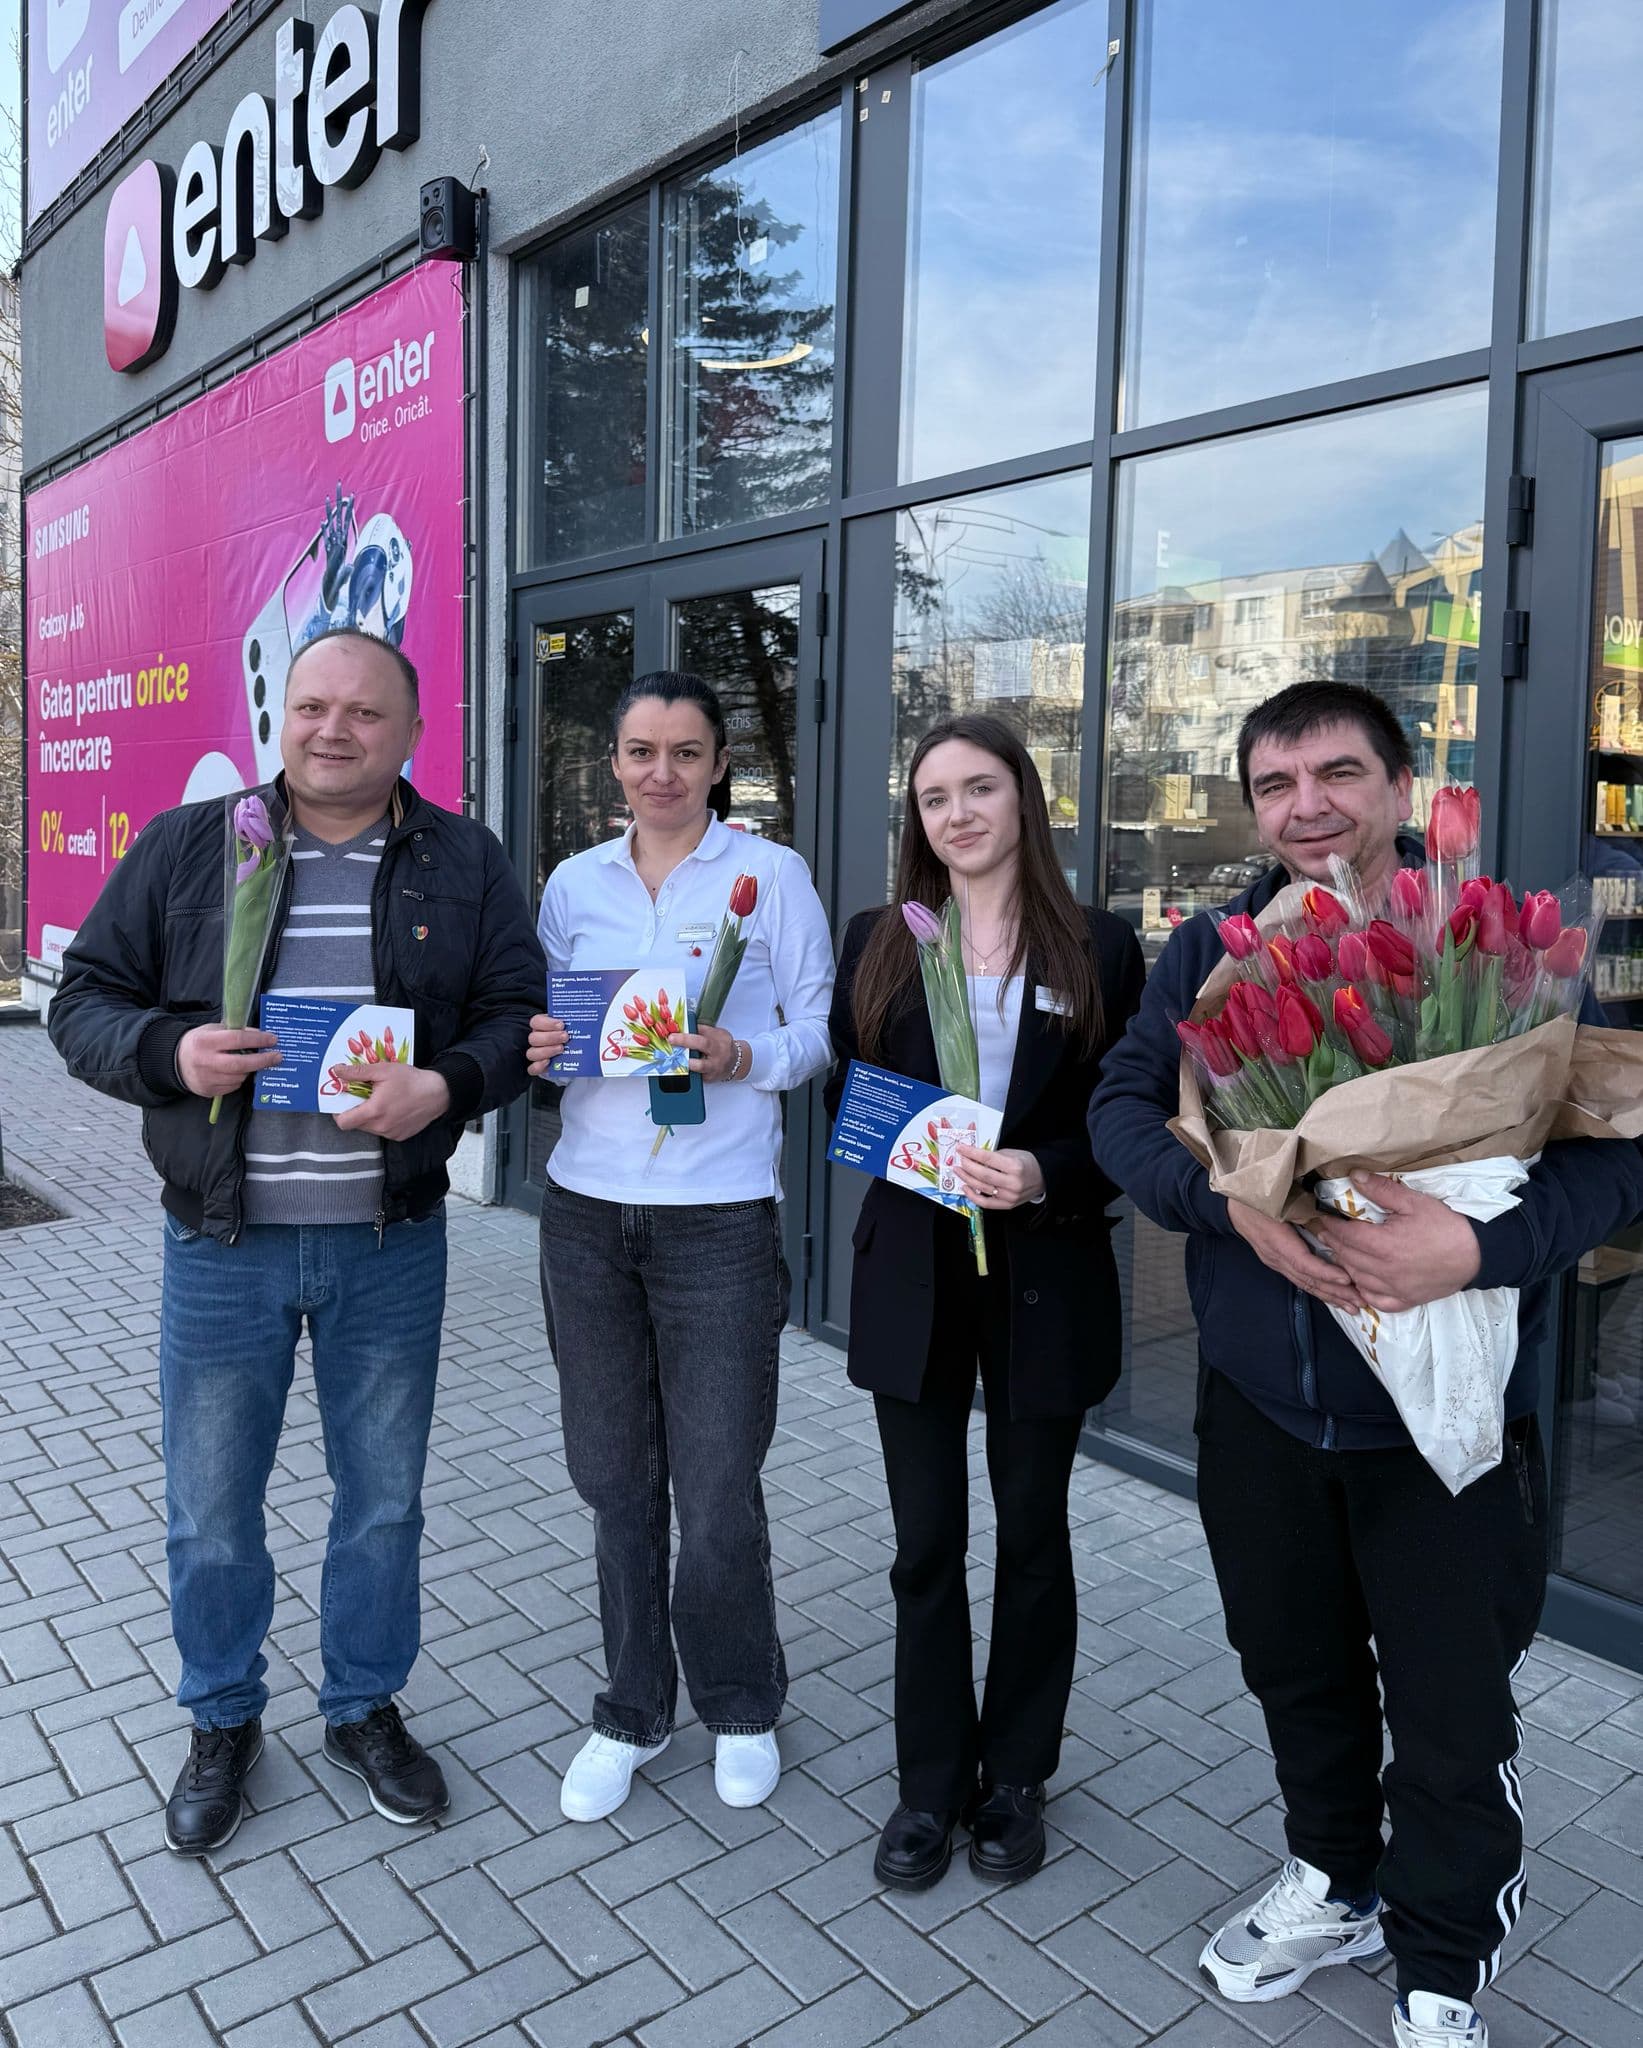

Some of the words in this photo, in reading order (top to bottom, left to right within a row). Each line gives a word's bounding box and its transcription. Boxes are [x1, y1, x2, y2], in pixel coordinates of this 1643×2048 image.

[47, 54, 93, 148] enter
[173, 0, 402, 288] enter
[359, 331, 435, 409] enter
[360, 417, 392, 443] Orice.
[395, 395, 433, 428] Oricât.
[35, 504, 89, 560] SAMSUNG
[39, 613, 68, 642] Galaxy
[70, 603, 84, 632] A16
[40, 679, 73, 720] Gata
[76, 669, 132, 727] pentru
[136, 653, 189, 707] orice
[39, 731, 112, 773] încercare
[40, 810, 65, 854] 0%
[67, 828, 97, 857] credit
[109, 812, 130, 859] 12
